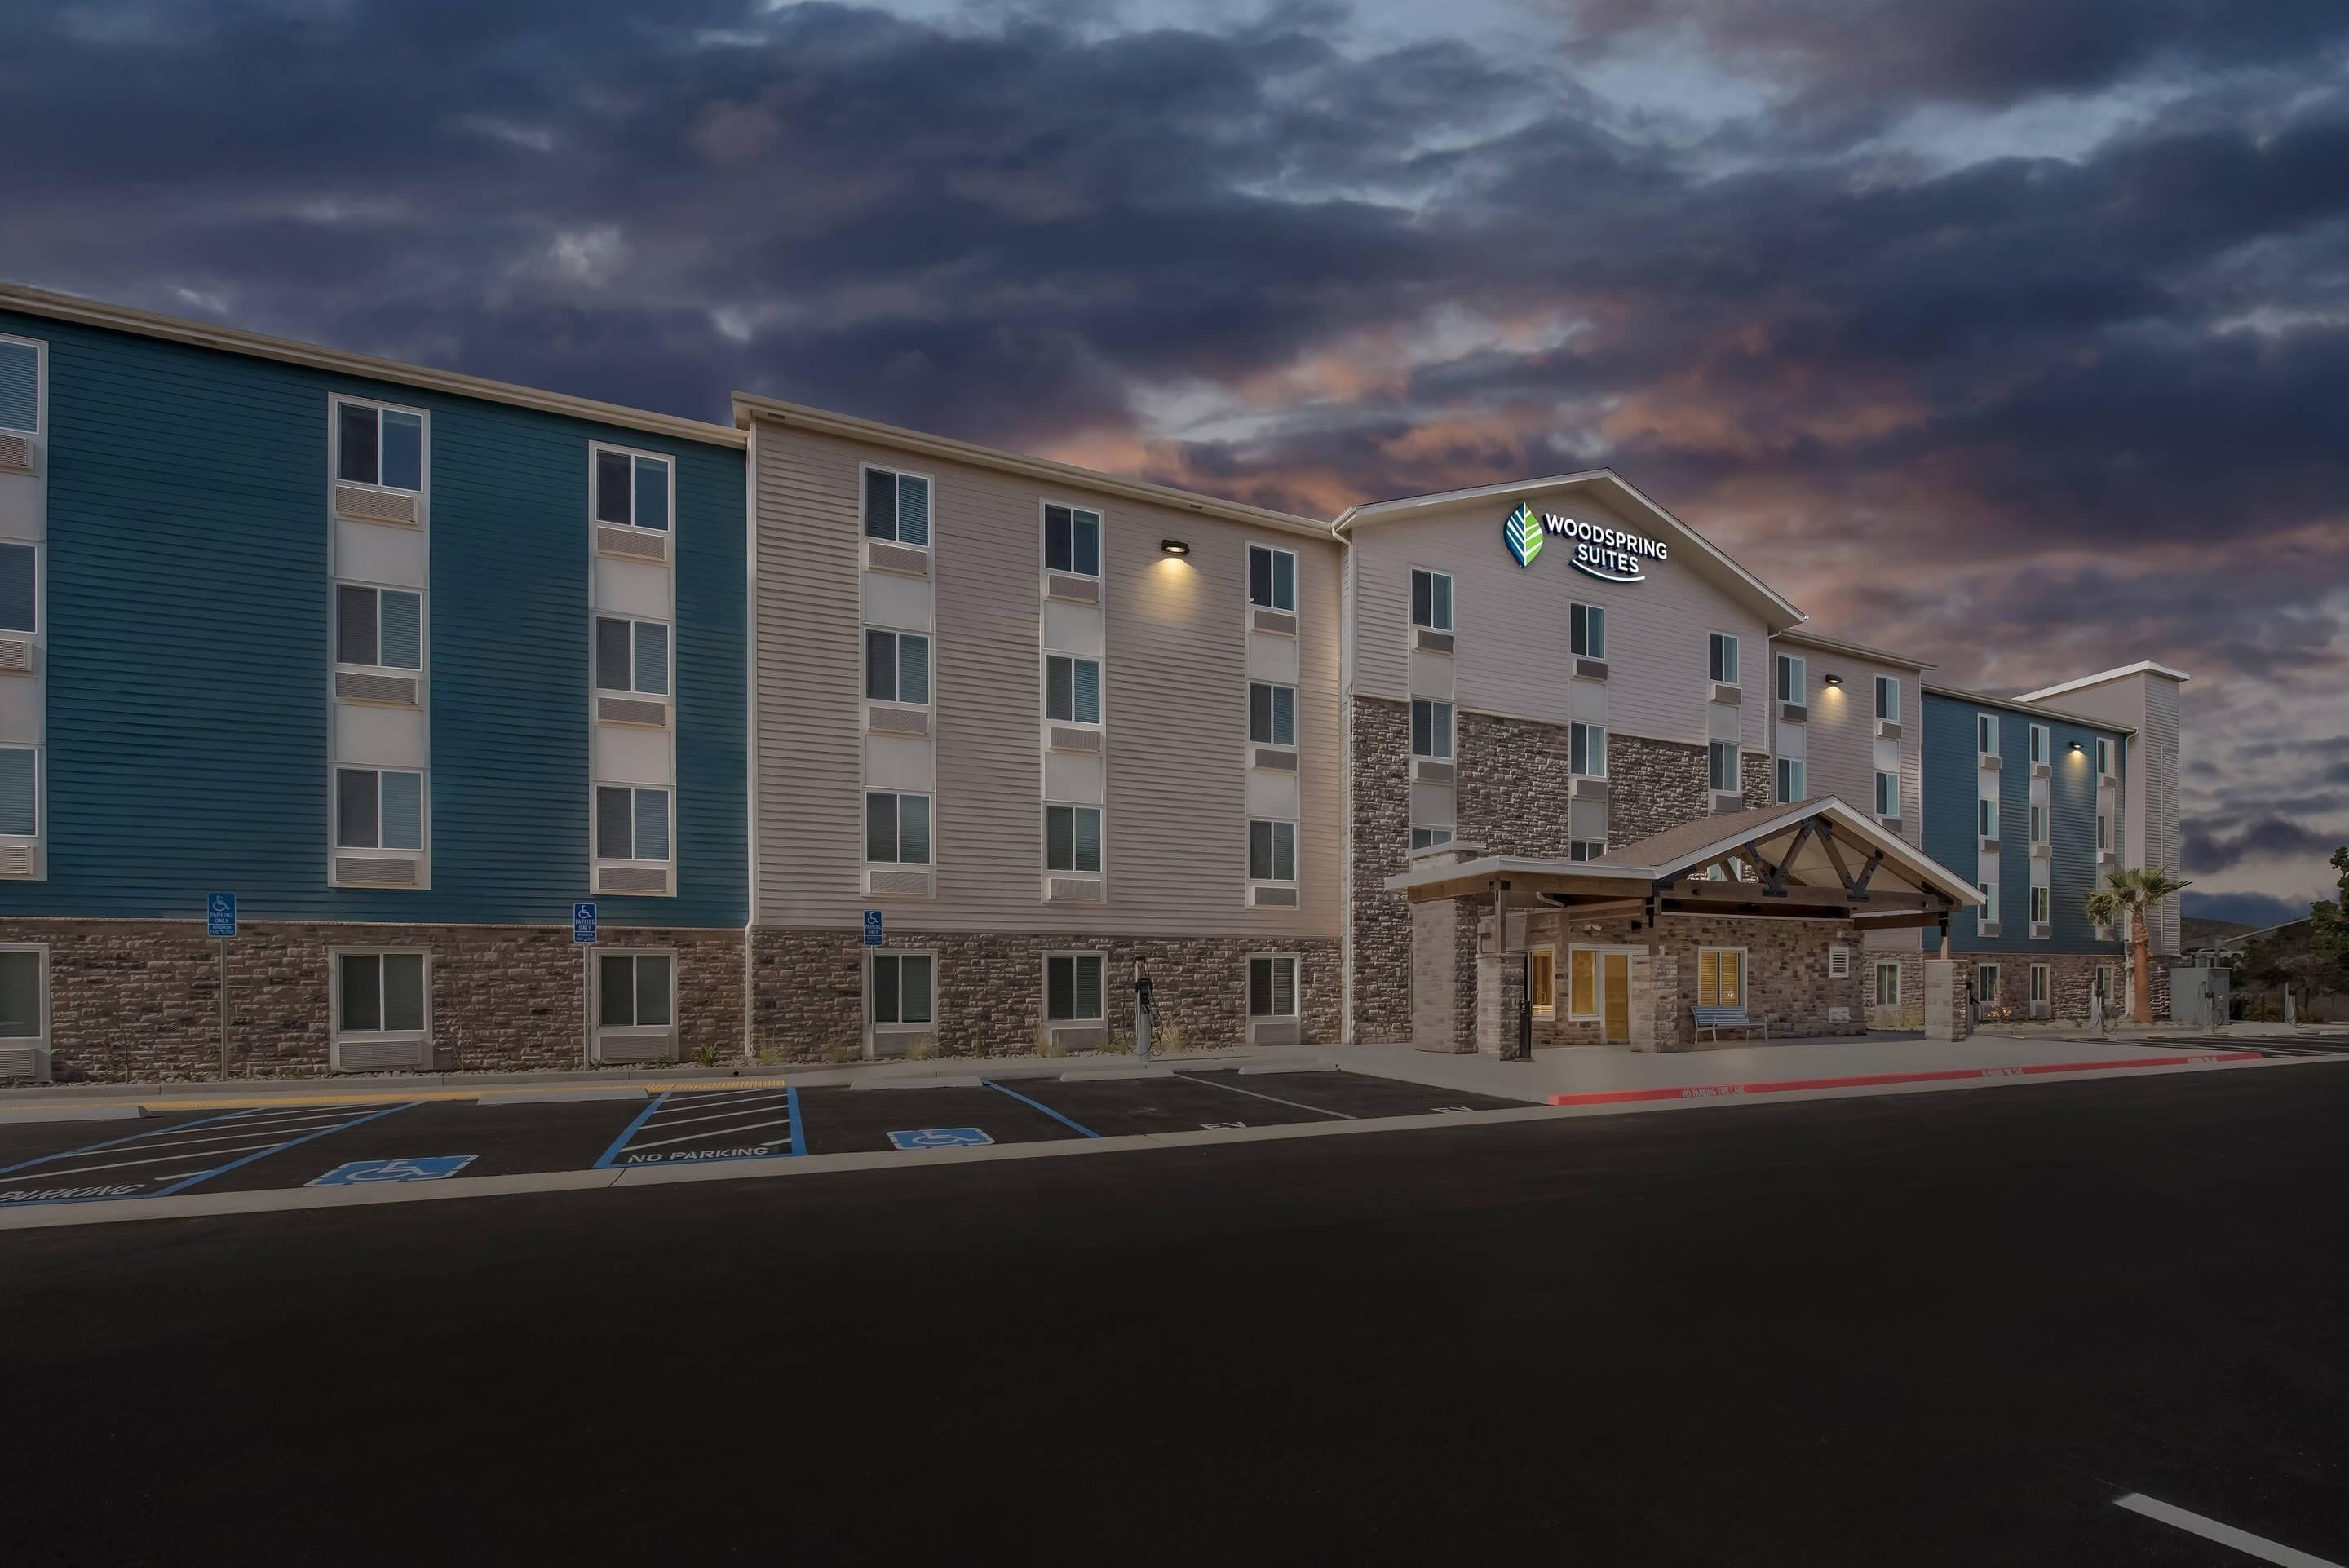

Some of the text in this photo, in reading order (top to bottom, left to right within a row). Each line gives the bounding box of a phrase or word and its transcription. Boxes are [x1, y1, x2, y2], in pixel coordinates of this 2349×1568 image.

[1544, 512, 1668, 560] WOODSPRING
[1576, 543, 1639, 573] SUITES
[1683, 1089, 1691, 1098] NO
[627, 1147, 769, 1163] NO PARKING
